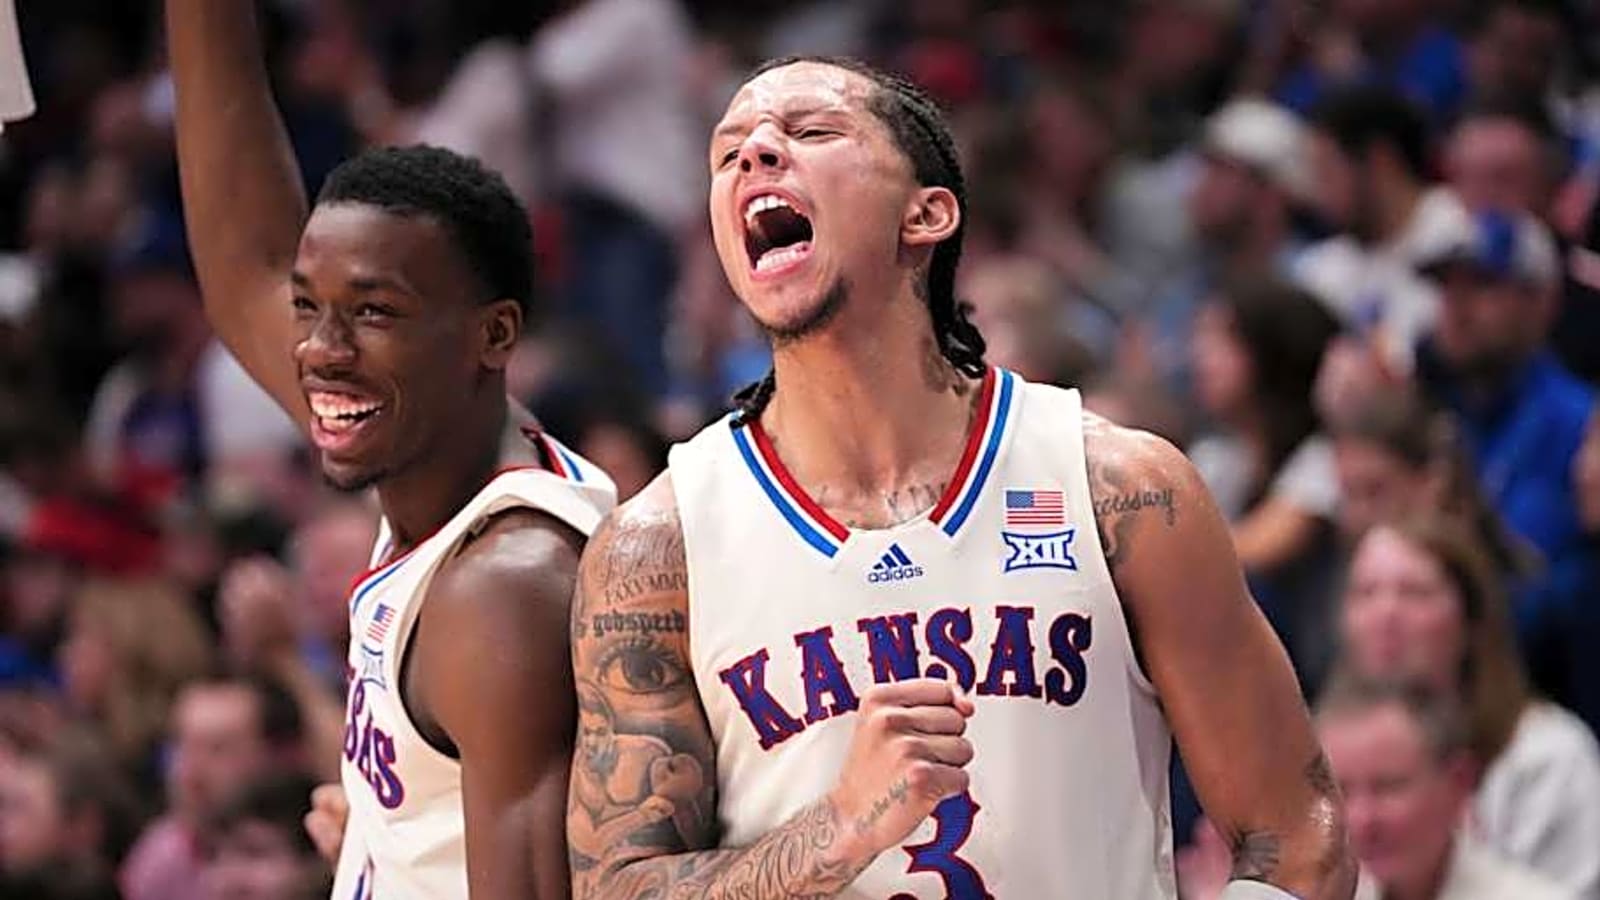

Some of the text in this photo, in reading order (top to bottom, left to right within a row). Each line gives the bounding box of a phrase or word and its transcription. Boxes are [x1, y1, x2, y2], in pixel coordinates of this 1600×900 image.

[867, 563, 924, 584] adidas
[1001, 529, 1077, 572] XII
[719, 605, 1093, 751] KANSAS
[888, 791, 996, 900] 3
